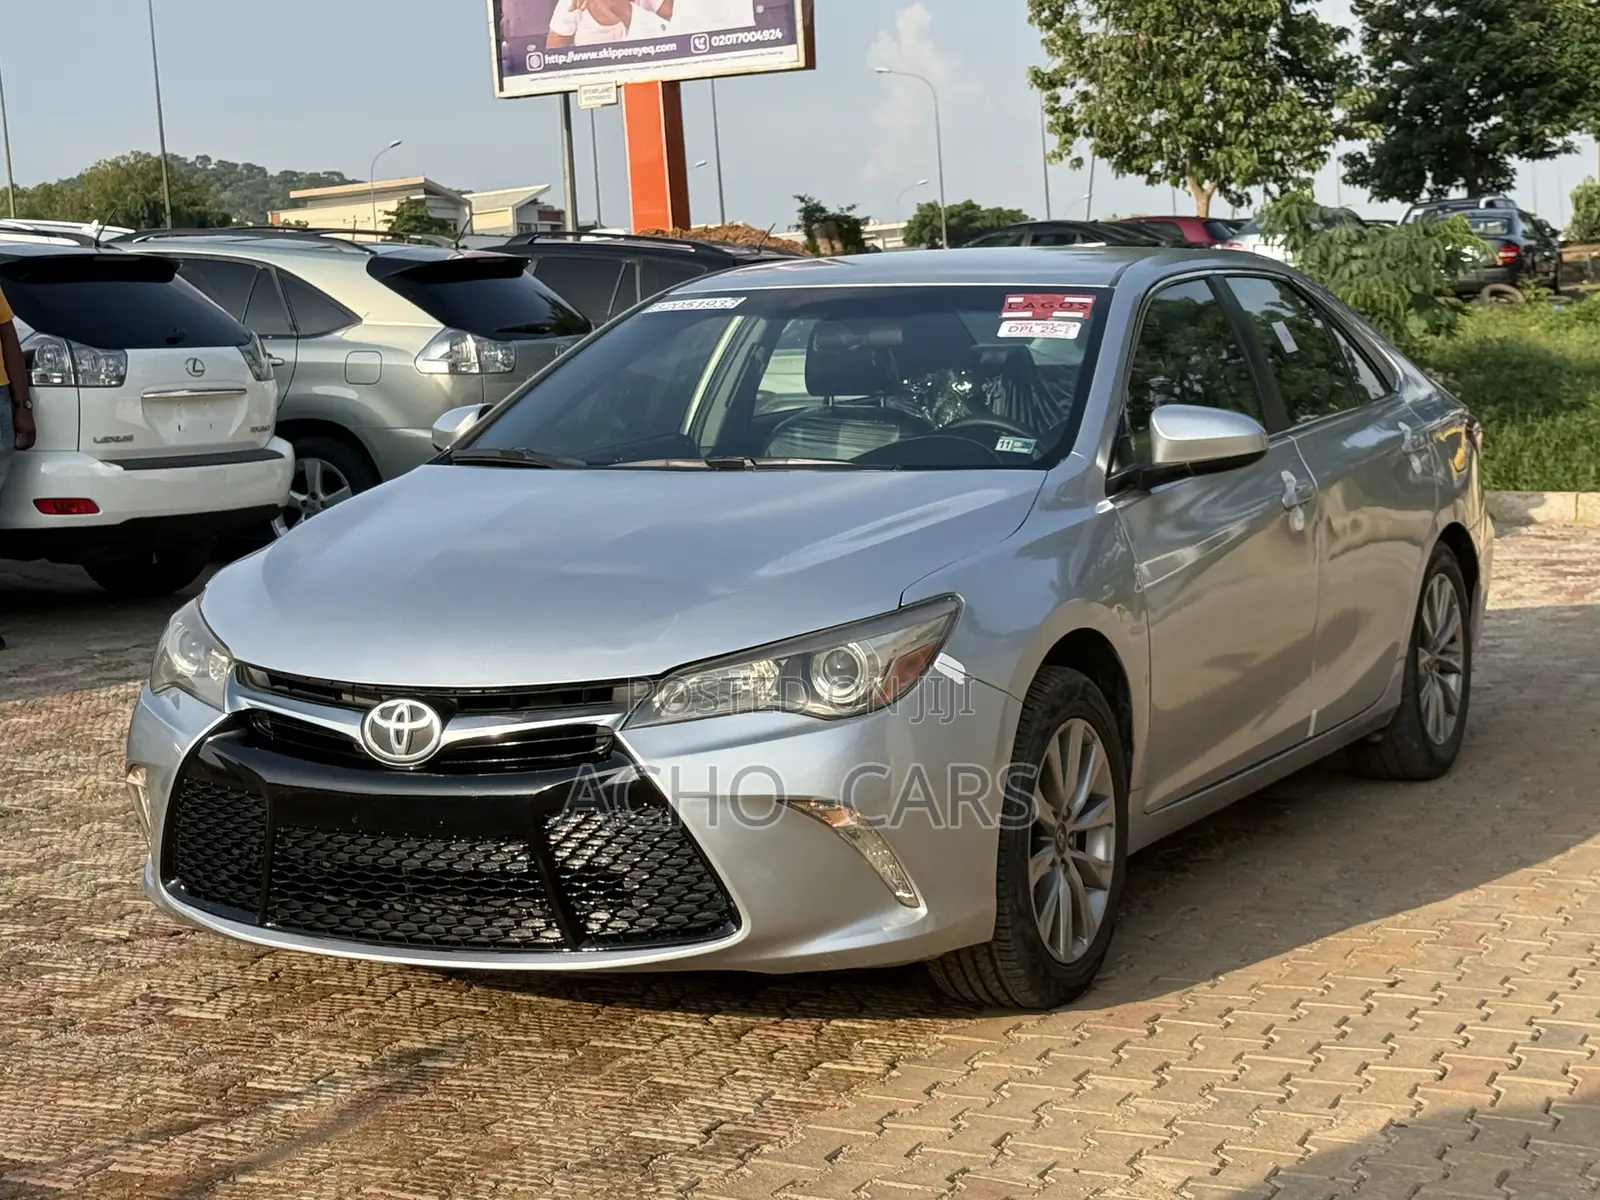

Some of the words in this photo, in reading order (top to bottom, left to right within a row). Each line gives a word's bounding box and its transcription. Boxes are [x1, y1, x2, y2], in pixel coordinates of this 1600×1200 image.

[711, 28, 783, 47] 02017004924
[1008, 301, 1088, 310] LAGOS
[1008, 325, 1035, 333] DPL
[999, 440, 1011, 449] 11
